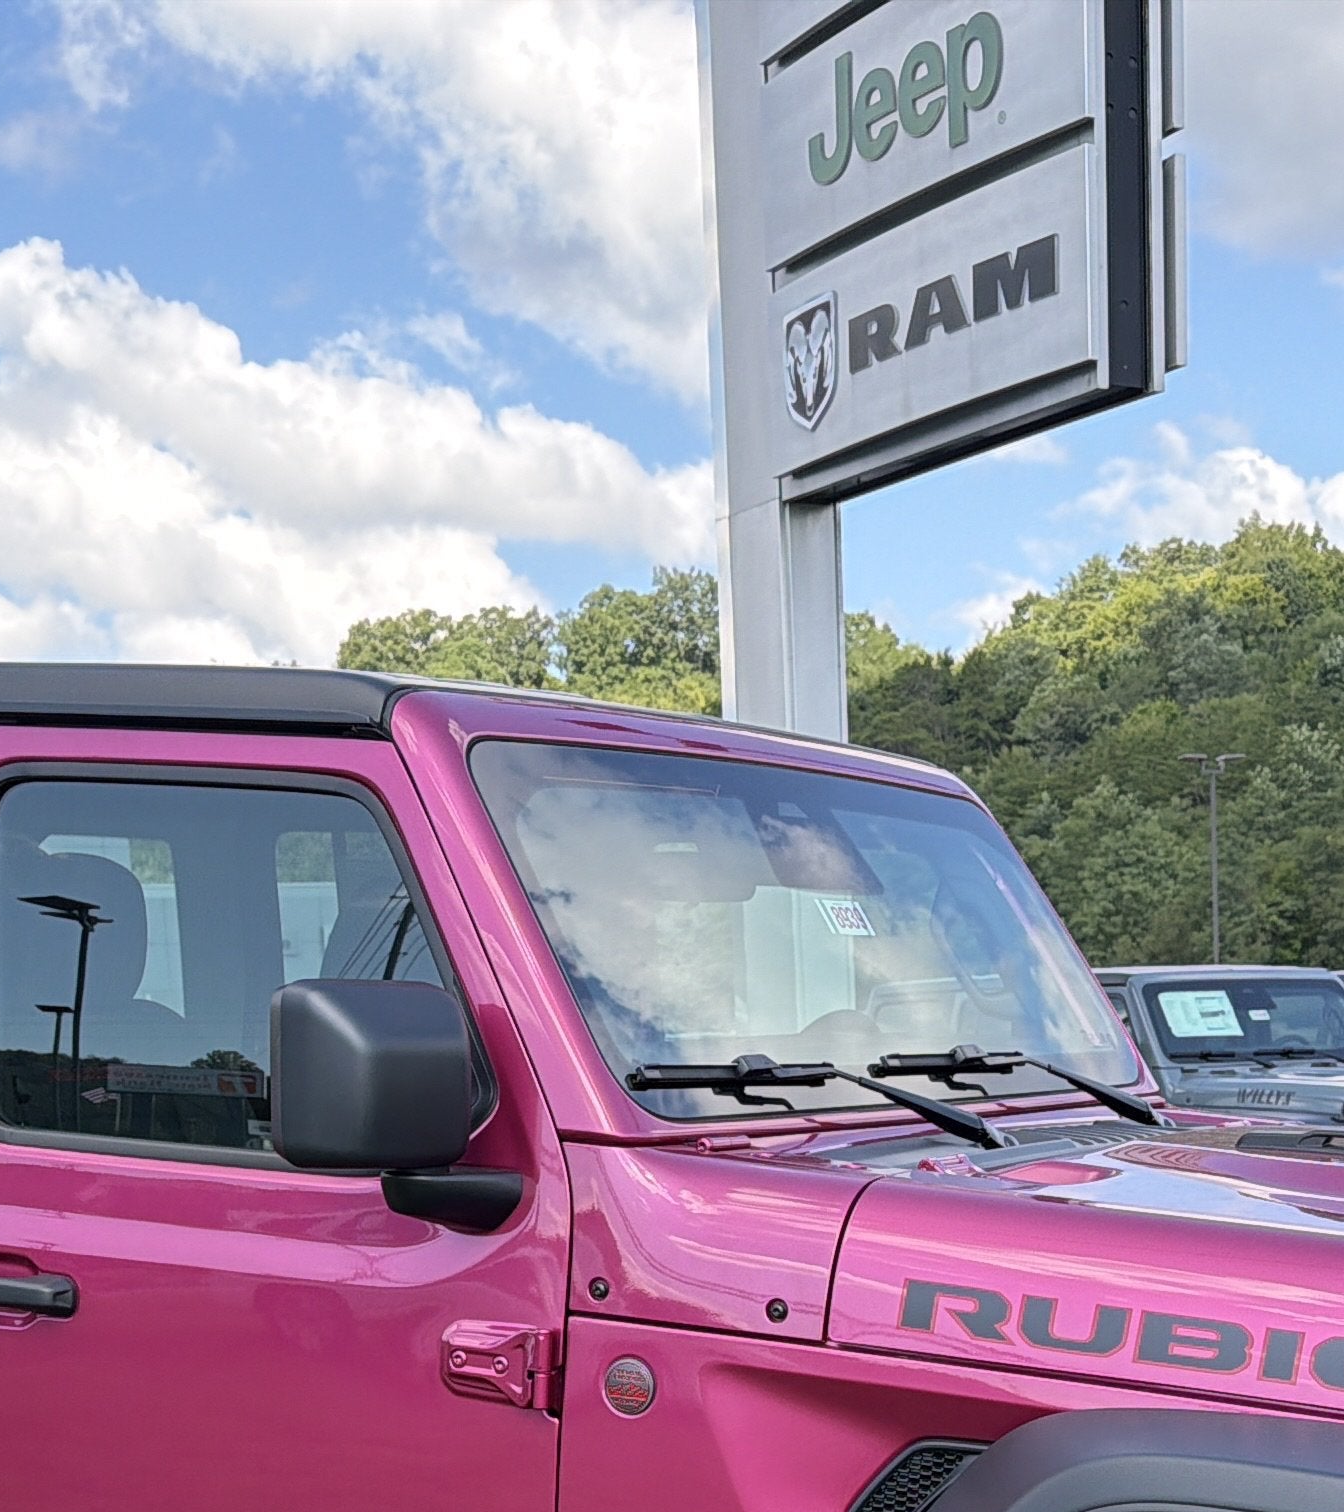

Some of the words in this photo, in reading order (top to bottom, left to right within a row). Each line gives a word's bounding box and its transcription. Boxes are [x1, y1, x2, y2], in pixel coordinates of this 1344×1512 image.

[808, 11, 1004, 186] Jeep
[849, 233, 1059, 375] RAM
[1236, 1087, 1297, 1107] WILLYS
